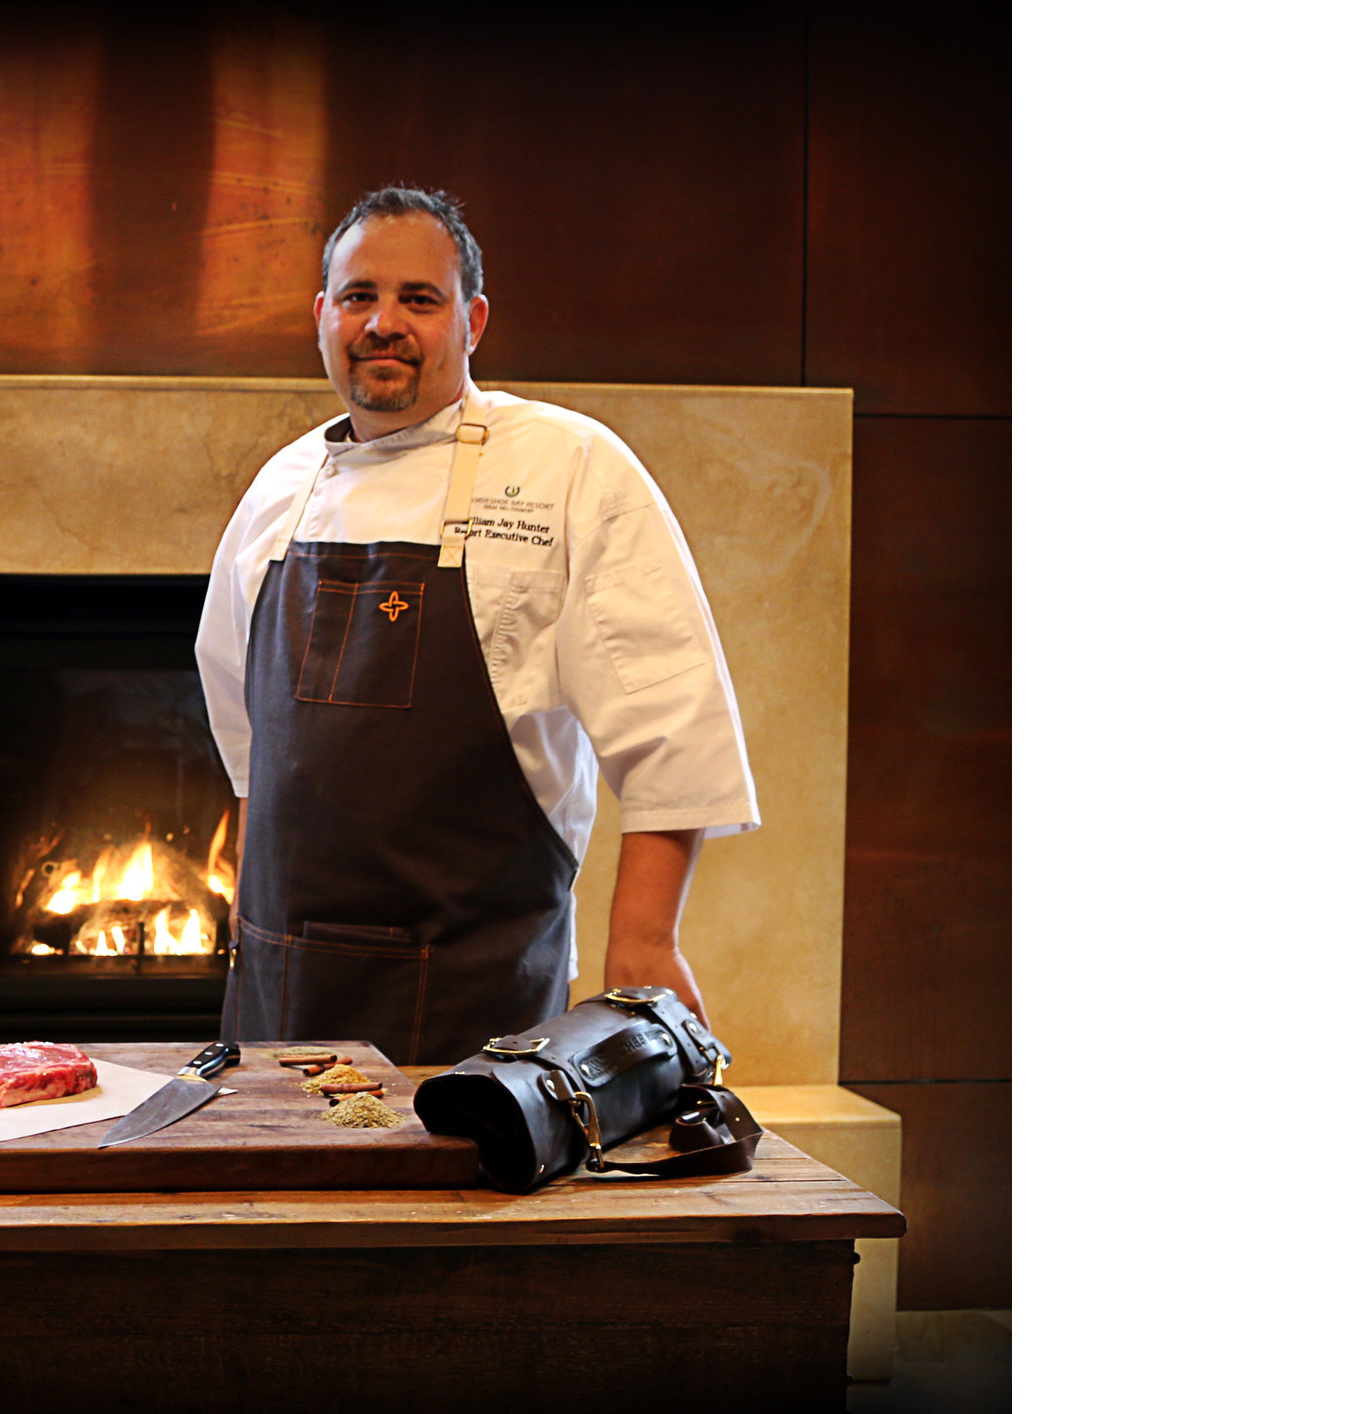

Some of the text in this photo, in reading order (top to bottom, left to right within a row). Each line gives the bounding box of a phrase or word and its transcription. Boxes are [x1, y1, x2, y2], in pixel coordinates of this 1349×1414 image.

[497, 518, 515, 531] Jay
[516, 520, 549, 533] Hunter
[484, 530, 528, 543] Executive
[531, 535, 554, 547] Chef
